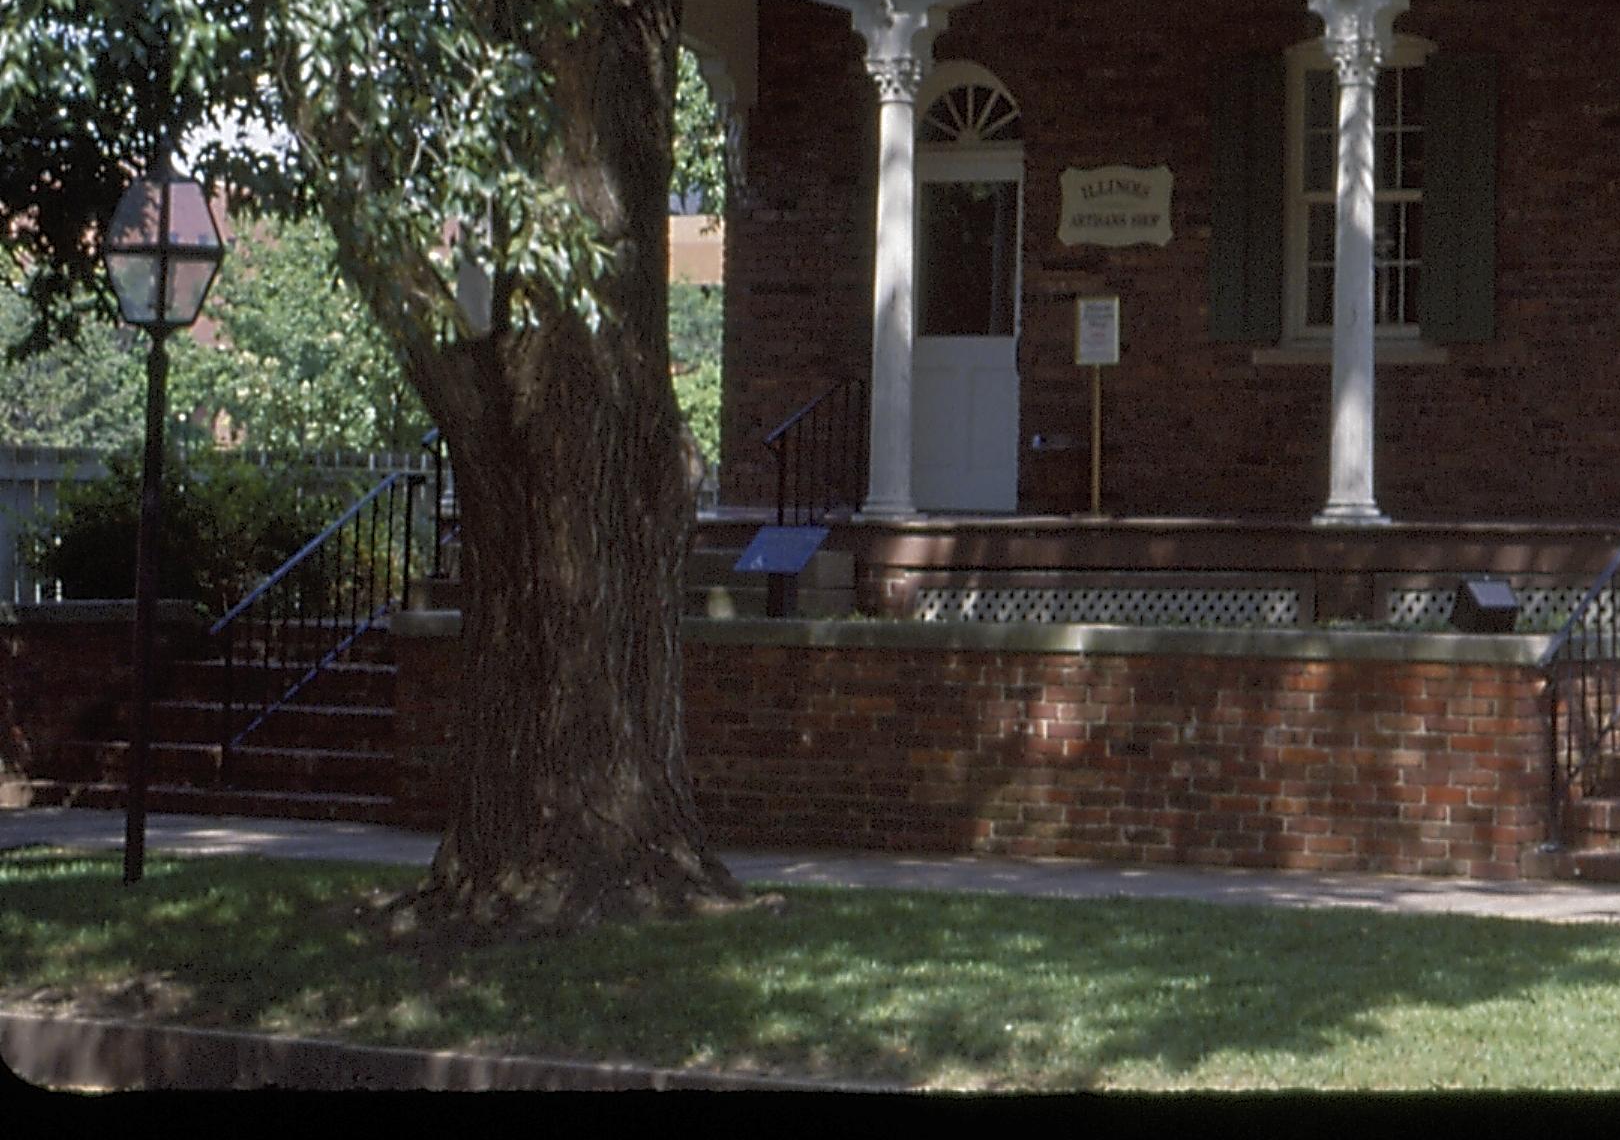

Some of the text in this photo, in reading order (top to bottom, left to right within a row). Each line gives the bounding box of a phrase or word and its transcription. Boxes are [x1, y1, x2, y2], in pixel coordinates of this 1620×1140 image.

[1080, 179, 1151, 200] ILLINOIS
[1070, 212, 1160, 228] ARTISANS SHOP
